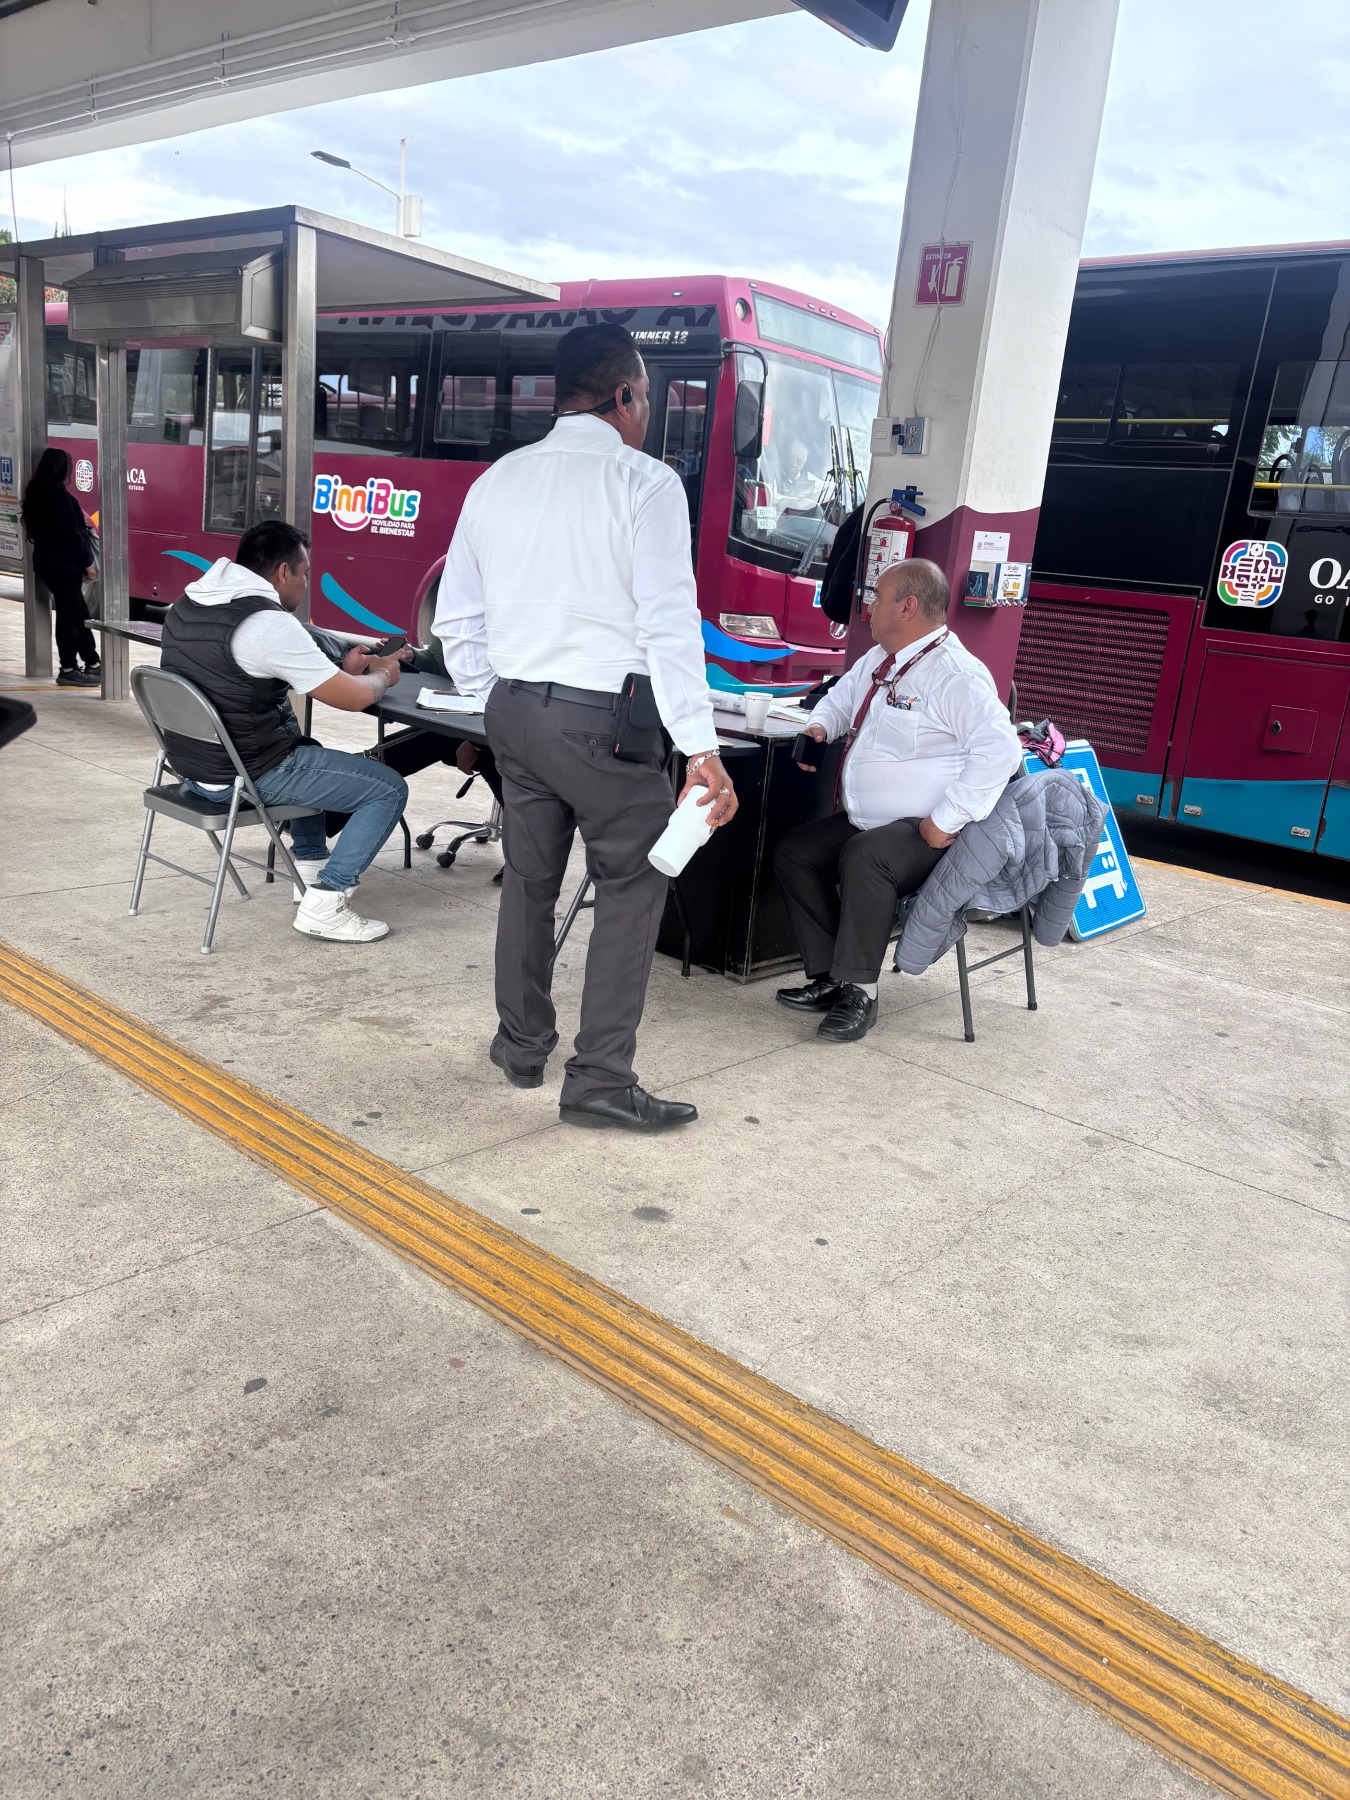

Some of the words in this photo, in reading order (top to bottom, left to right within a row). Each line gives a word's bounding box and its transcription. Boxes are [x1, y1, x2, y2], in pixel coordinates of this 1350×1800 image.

[926, 253, 952, 261] EXTINOR
[672, 331, 689, 344] 12
[314, 478, 418, 519] BinniBus
[372, 519, 400, 528] MOVILIDAD
[380, 529, 414, 537] BIENESTAR
